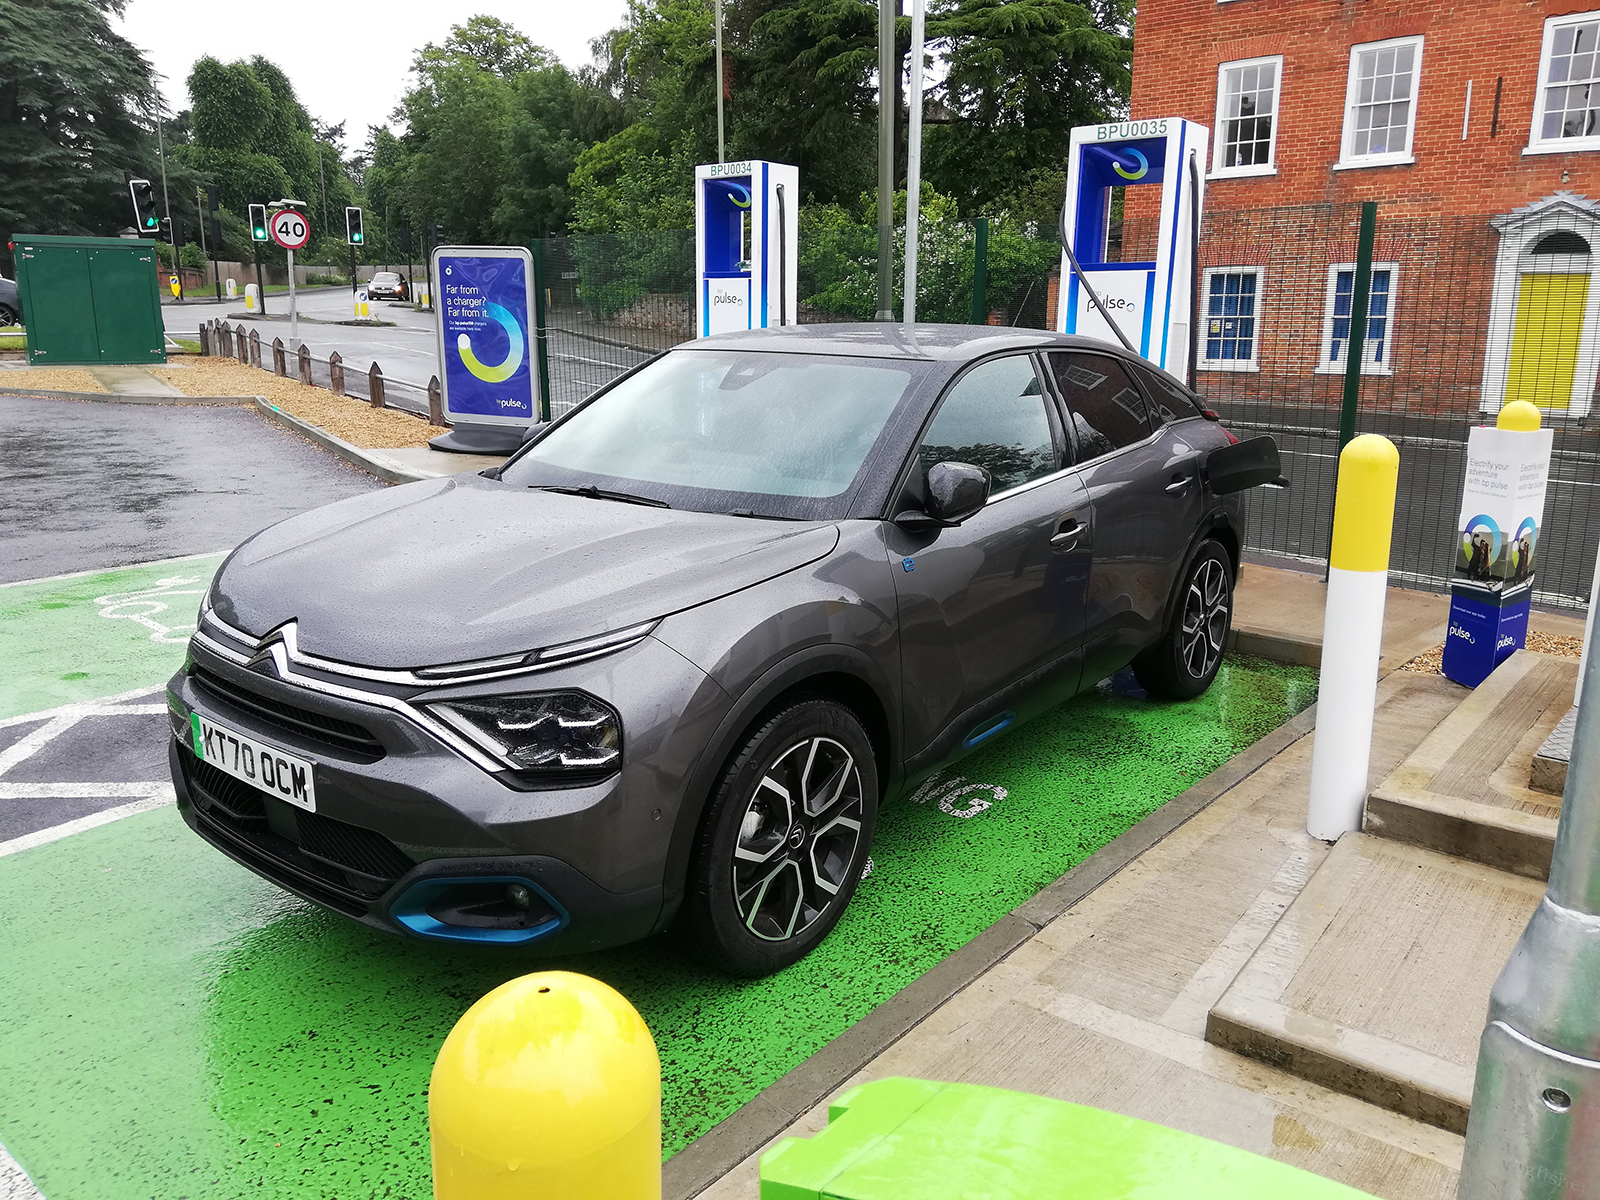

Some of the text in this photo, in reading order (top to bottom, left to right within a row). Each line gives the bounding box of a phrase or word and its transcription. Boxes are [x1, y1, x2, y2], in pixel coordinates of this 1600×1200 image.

[1097, 119, 1168, 140] BPU0035
[711, 162, 752, 176] BPU0034
[278, 221, 305, 238] 40
[446, 284, 479, 295] Far from
[446, 296, 487, 308] a charger?
[714, 292, 737, 306] pulse
[448, 306, 460, 317] Far
[461, 307, 480, 318] from
[501, 398, 521, 408] pulse
[1469, 457, 1509, 471] Electrify your
[1468, 468, 1498, 479] adventure
[1481, 479, 1490, 488] bp
[1490, 481, 1508, 490] pulse
[1449, 626, 1470, 640] pulse
[1496, 635, 1514, 651] pulse
[202, 723, 308, 803] KT70 OCM
